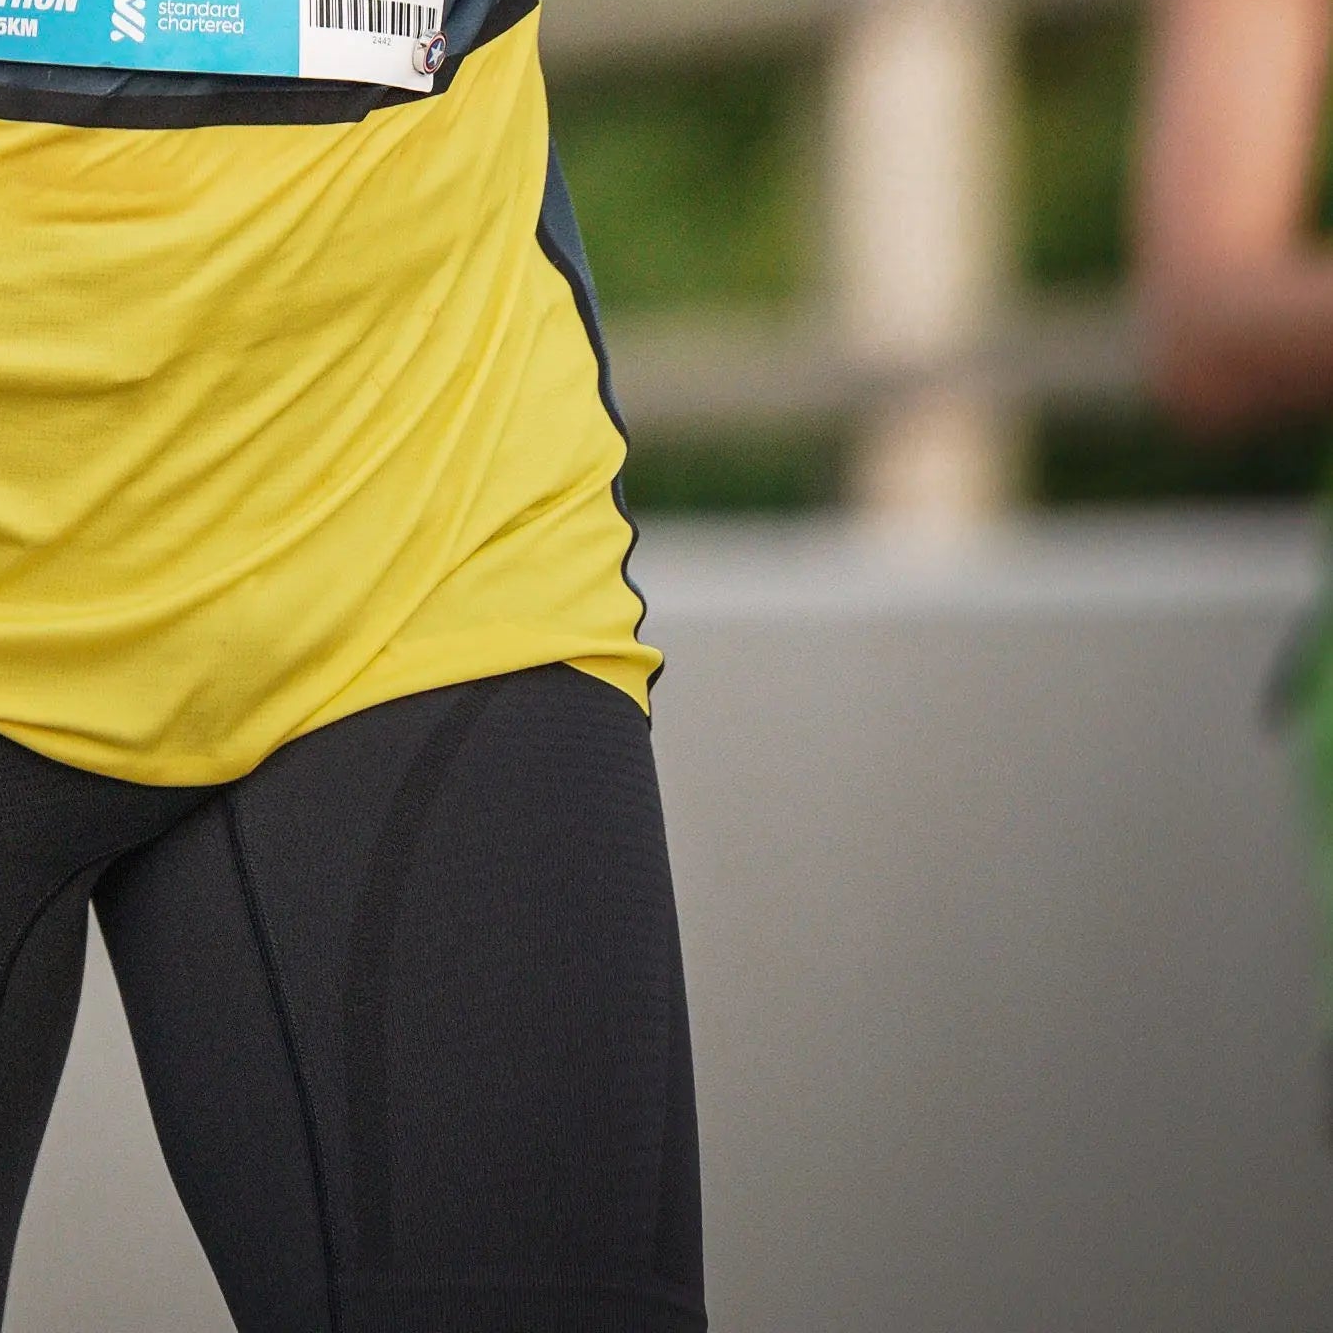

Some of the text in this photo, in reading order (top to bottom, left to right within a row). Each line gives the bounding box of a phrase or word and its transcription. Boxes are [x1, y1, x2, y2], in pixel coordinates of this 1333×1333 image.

[158, 0, 240, 18] standard
[157, 17, 245, 35] chartered
[372, 35, 392, 47] 2442
